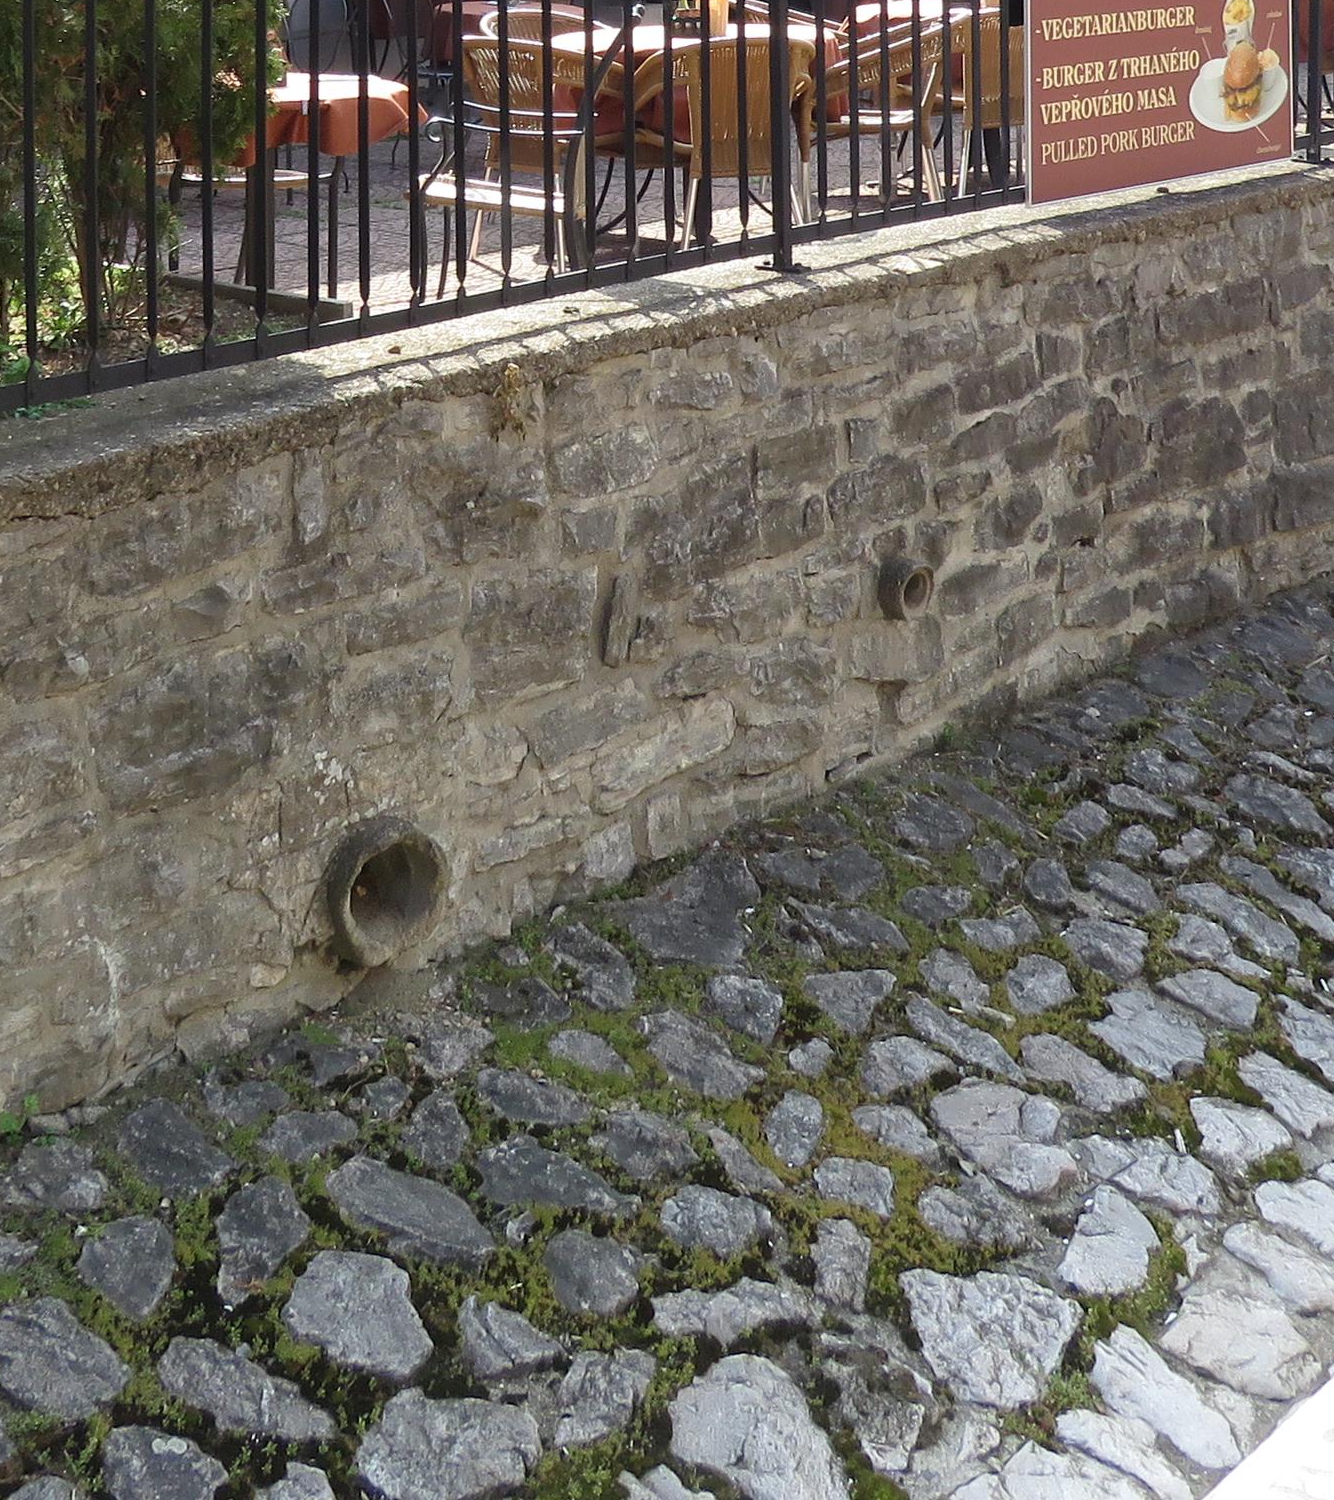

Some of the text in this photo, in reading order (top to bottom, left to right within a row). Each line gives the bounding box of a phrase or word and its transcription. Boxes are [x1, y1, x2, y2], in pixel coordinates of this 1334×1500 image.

[1108, 63, 1118, 80] Z
[1120, 47, 1200, 79] TRHANÉHO
[1040, 86, 1178, 125] VEPŘOVÉHO MASA
[1041, 120, 1195, 165] PULLED PORK BURGER
